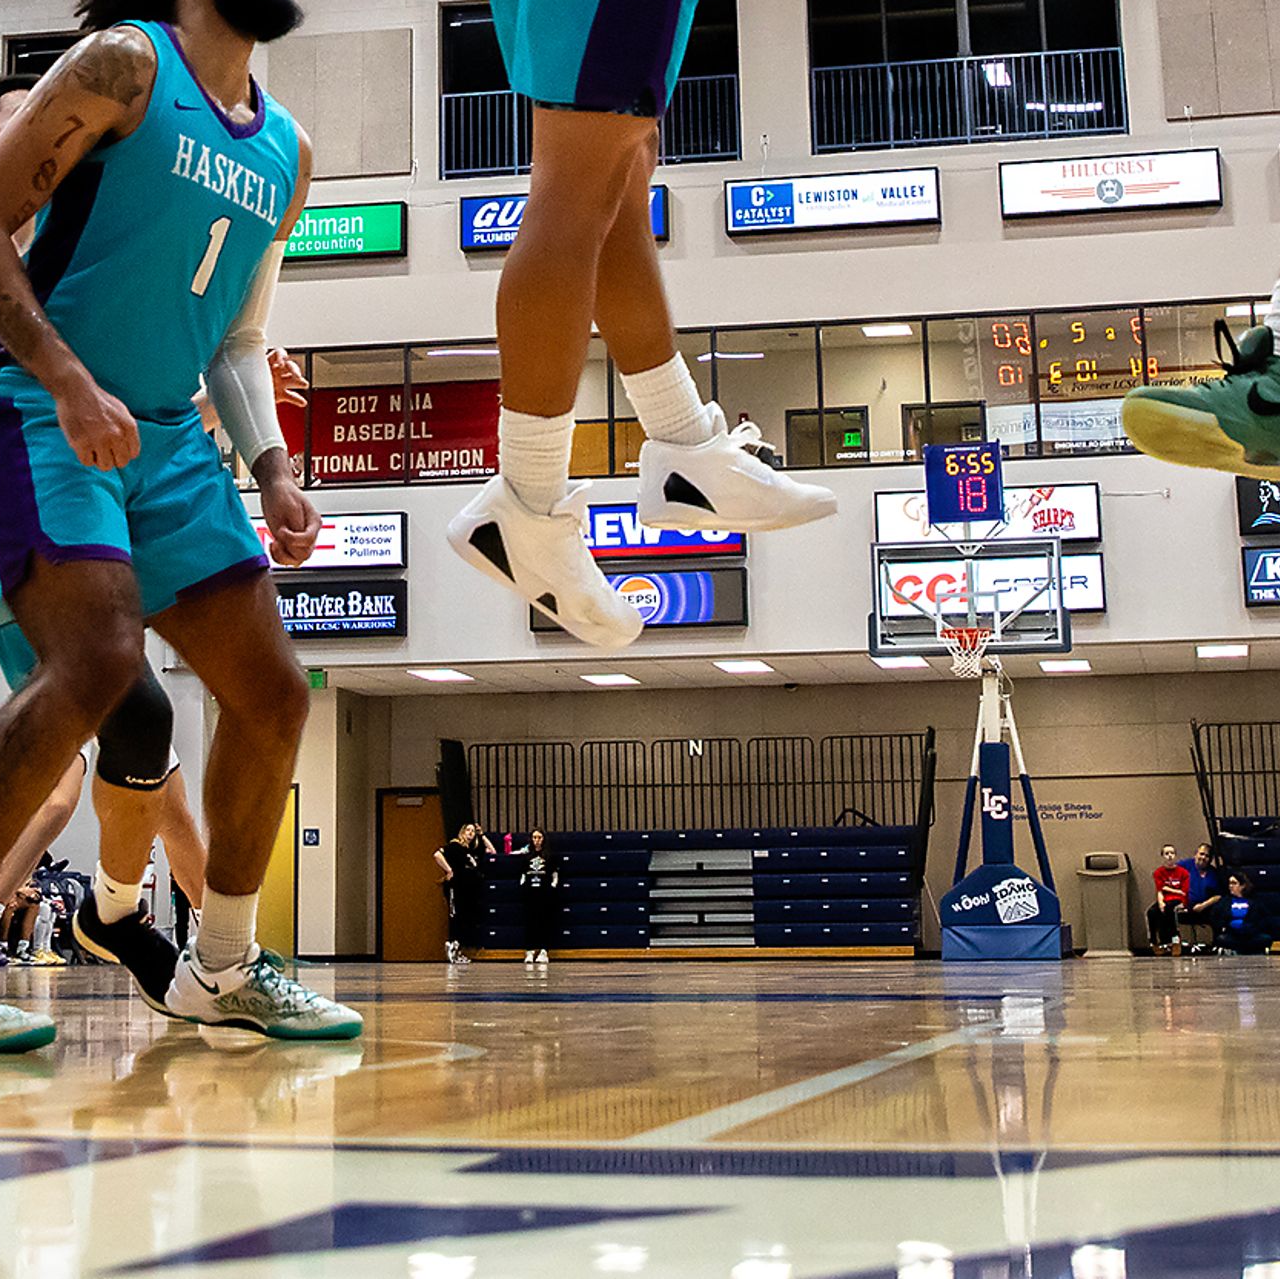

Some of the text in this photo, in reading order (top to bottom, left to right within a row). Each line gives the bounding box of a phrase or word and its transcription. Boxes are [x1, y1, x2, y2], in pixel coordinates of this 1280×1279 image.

[1062, 159, 1156, 178] HILLCREST
[171, 133, 278, 227] HASKELL
[798, 188, 858, 204] LEWISTON
[881, 185, 925, 200] VALLEY
[736, 207, 792, 220] CATALYST
[289, 236, 364, 253] accounting
[191, 215, 231, 297] 1
[1072, 380, 1111, 392] Former
[1150, 376, 1185, 386] arrior
[337, 396, 378, 414] 2017
[334, 422, 433, 442] BASEBALL
[945, 452, 995, 476] 6:55
[958, 476, 987, 513] 18
[350, 524, 396, 533] Lewiston
[350, 536, 391, 544] Moscow
[350, 548, 391, 557] Pullman
[1252, 589, 1274, 599] THE
[296, 593, 345, 618] RIVER
[348, 591, 396, 615] BANK
[688, 739, 703, 756] N
[982, 787, 1009, 820] LC
[1064, 802, 1093, 811] Shoes
[1040, 811, 1104, 822] On Gym Floor
